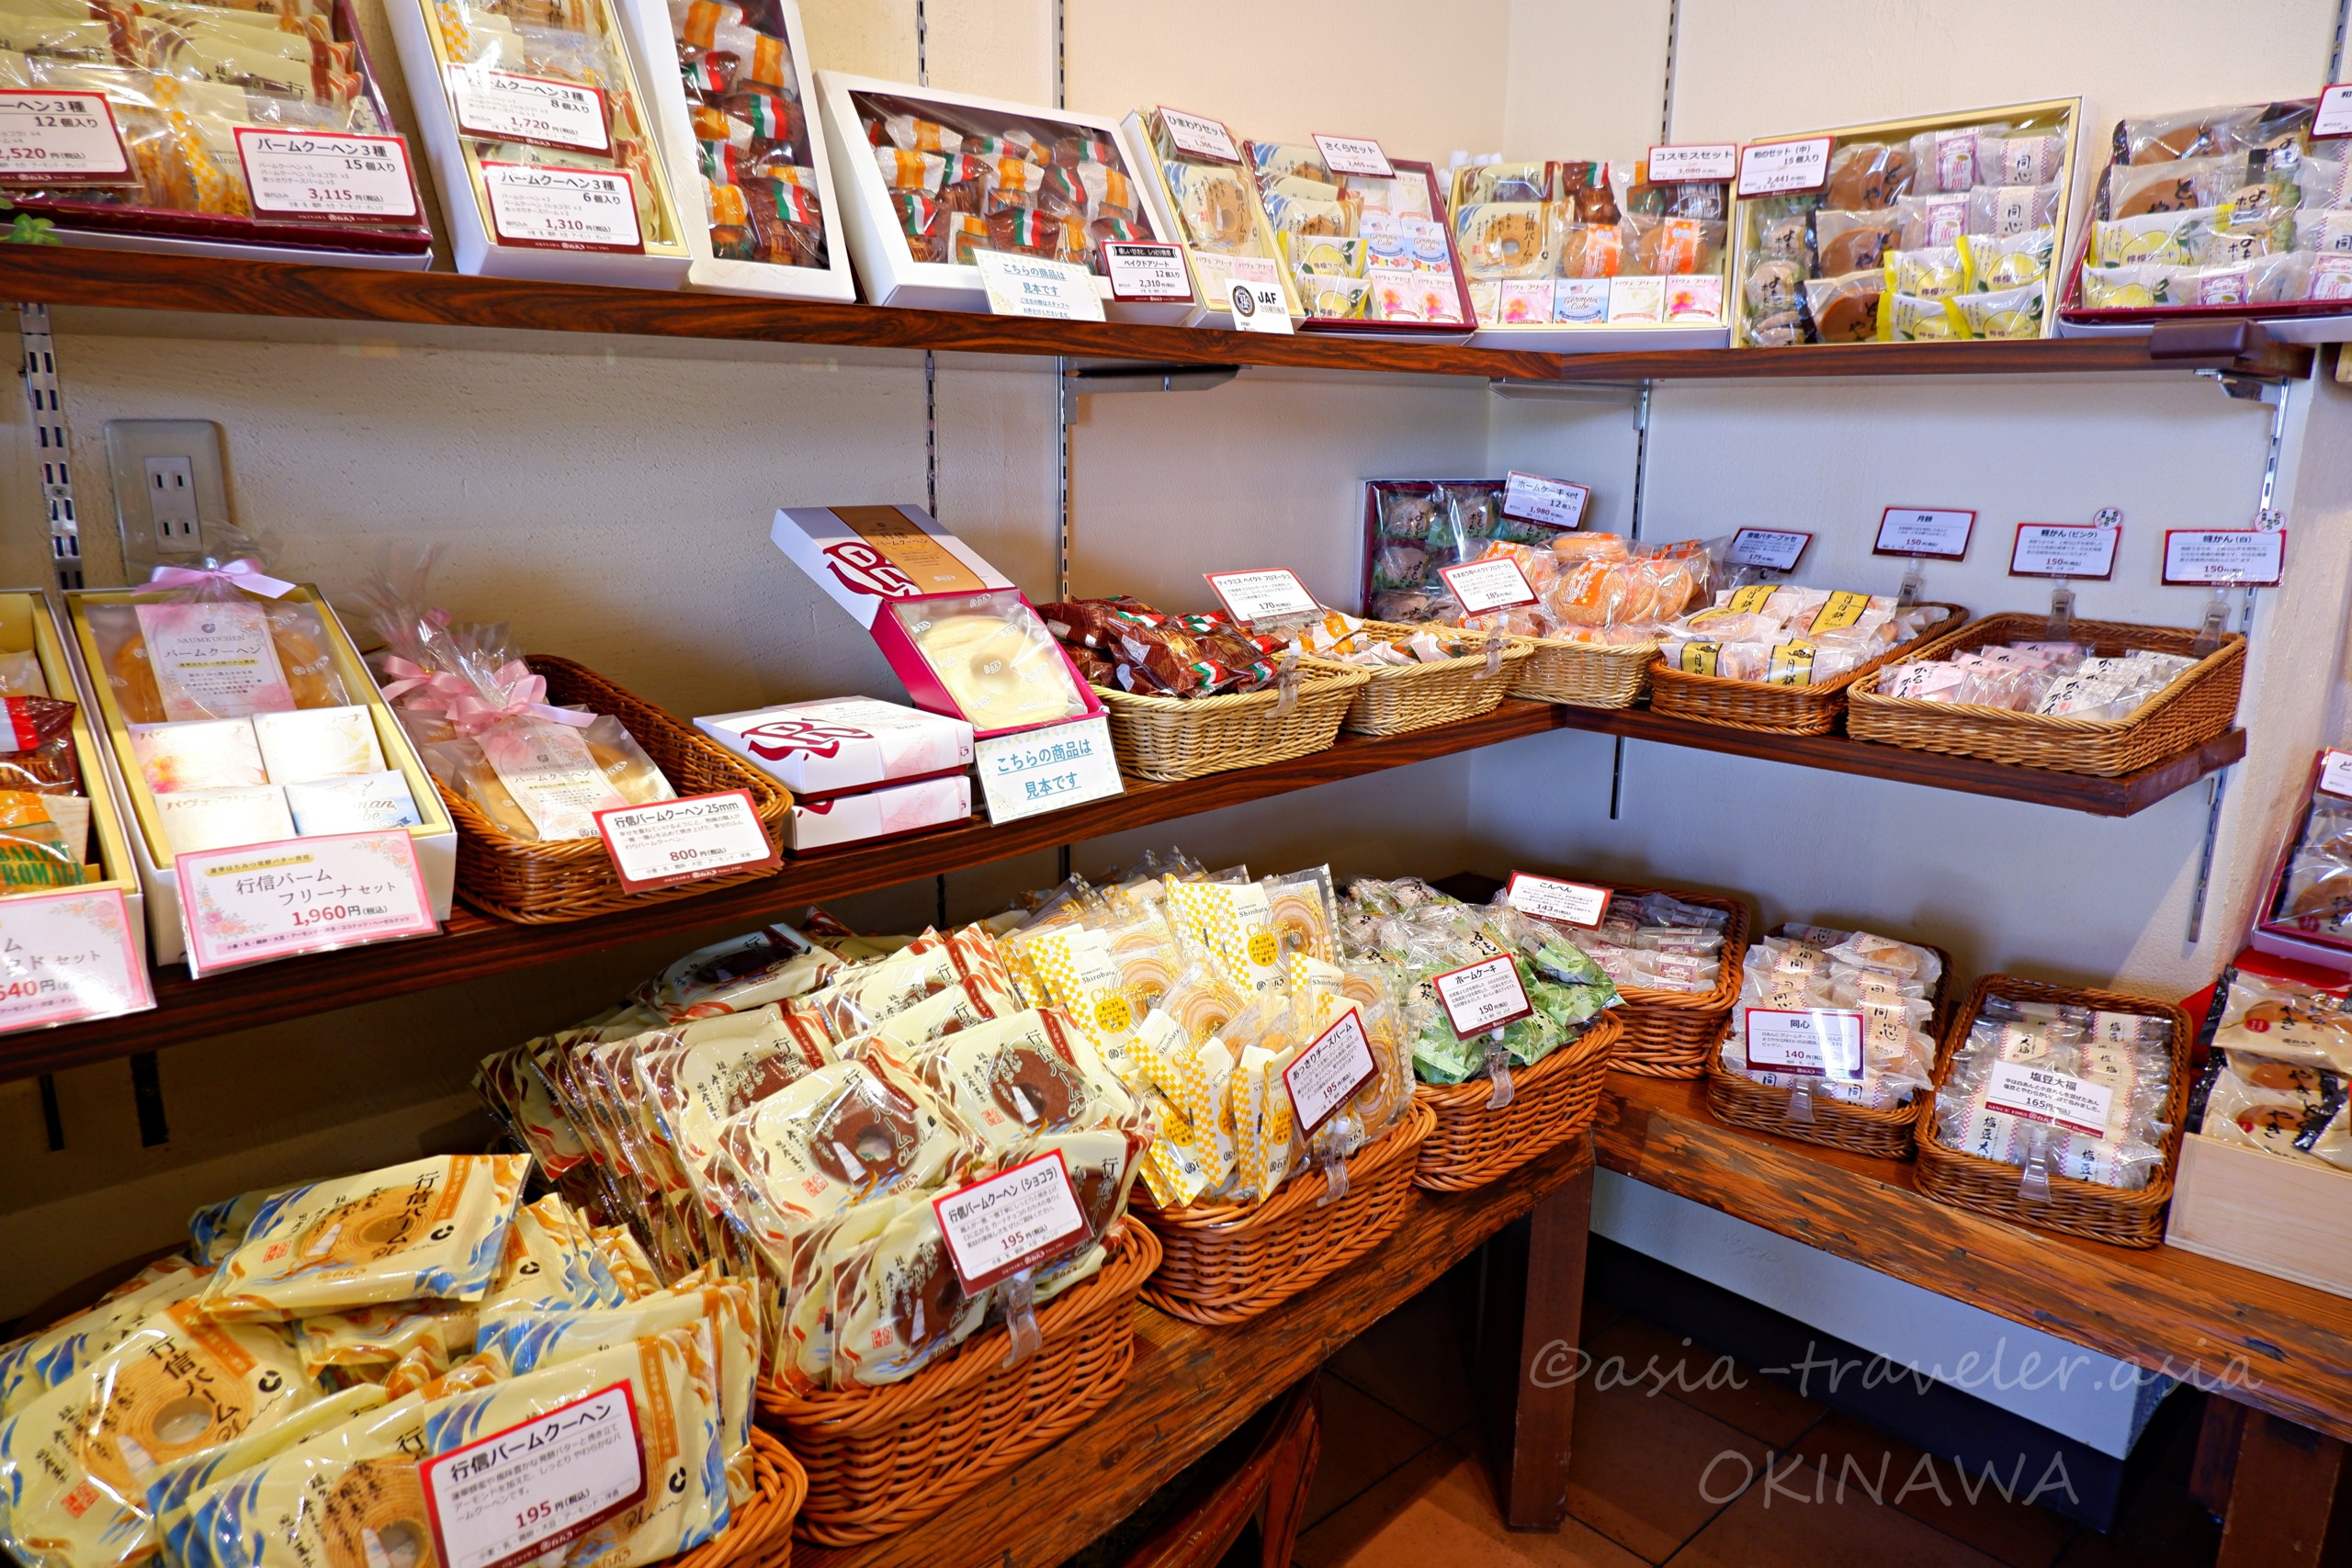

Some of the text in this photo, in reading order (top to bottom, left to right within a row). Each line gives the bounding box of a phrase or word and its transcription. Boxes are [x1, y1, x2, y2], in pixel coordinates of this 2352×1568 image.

[257, 138, 388, 158] バームクーヘン3種
[1325, 141, 1377, 154] さくらセット
[1655, 149, 1735, 164] コスモスセット
[1370, 232, 1398, 244] German
[1377, 240, 1394, 251] Cube
[1413, 236, 1441, 248] German
[1124, 259, 1170, 268] ベイクドアソート
[1003, 264, 1067, 280] こちらの商品は
[1023, 282, 1058, 296] 見本です
[1258, 291, 1277, 304] JAF
[1563, 296, 1599, 309] German
[1570, 306, 1590, 316] Cube
[1517, 479, 1579, 501] ホームケーキ set
[165, 645, 262, 659] バームクーヘン
[998, 739, 1092, 773] こちらの商品は
[1024, 771, 1078, 798] 見本です
[614, 801, 741, 829] 行信バームクーヘン 25mm
[236, 867, 334, 897] 行信バーム
[278, 880, 397, 908] フリーナ セット
[1238, 907, 1268, 919] Shirobara
[1455, 964, 1497, 986] ホームケーキ
[1790, 1019, 1811, 1030] 同心
[1292, 1021, 1353, 1081] あっさりチーズバーム
[2030, 1071, 2077, 1092] 塩豆大福
[1987, 1104, 2009, 1114] SINCE
[948, 1165, 1058, 1224] 行信バームクーヘン (ショコラ)
[450, 1404, 612, 1483] 行信バームクーヘン
